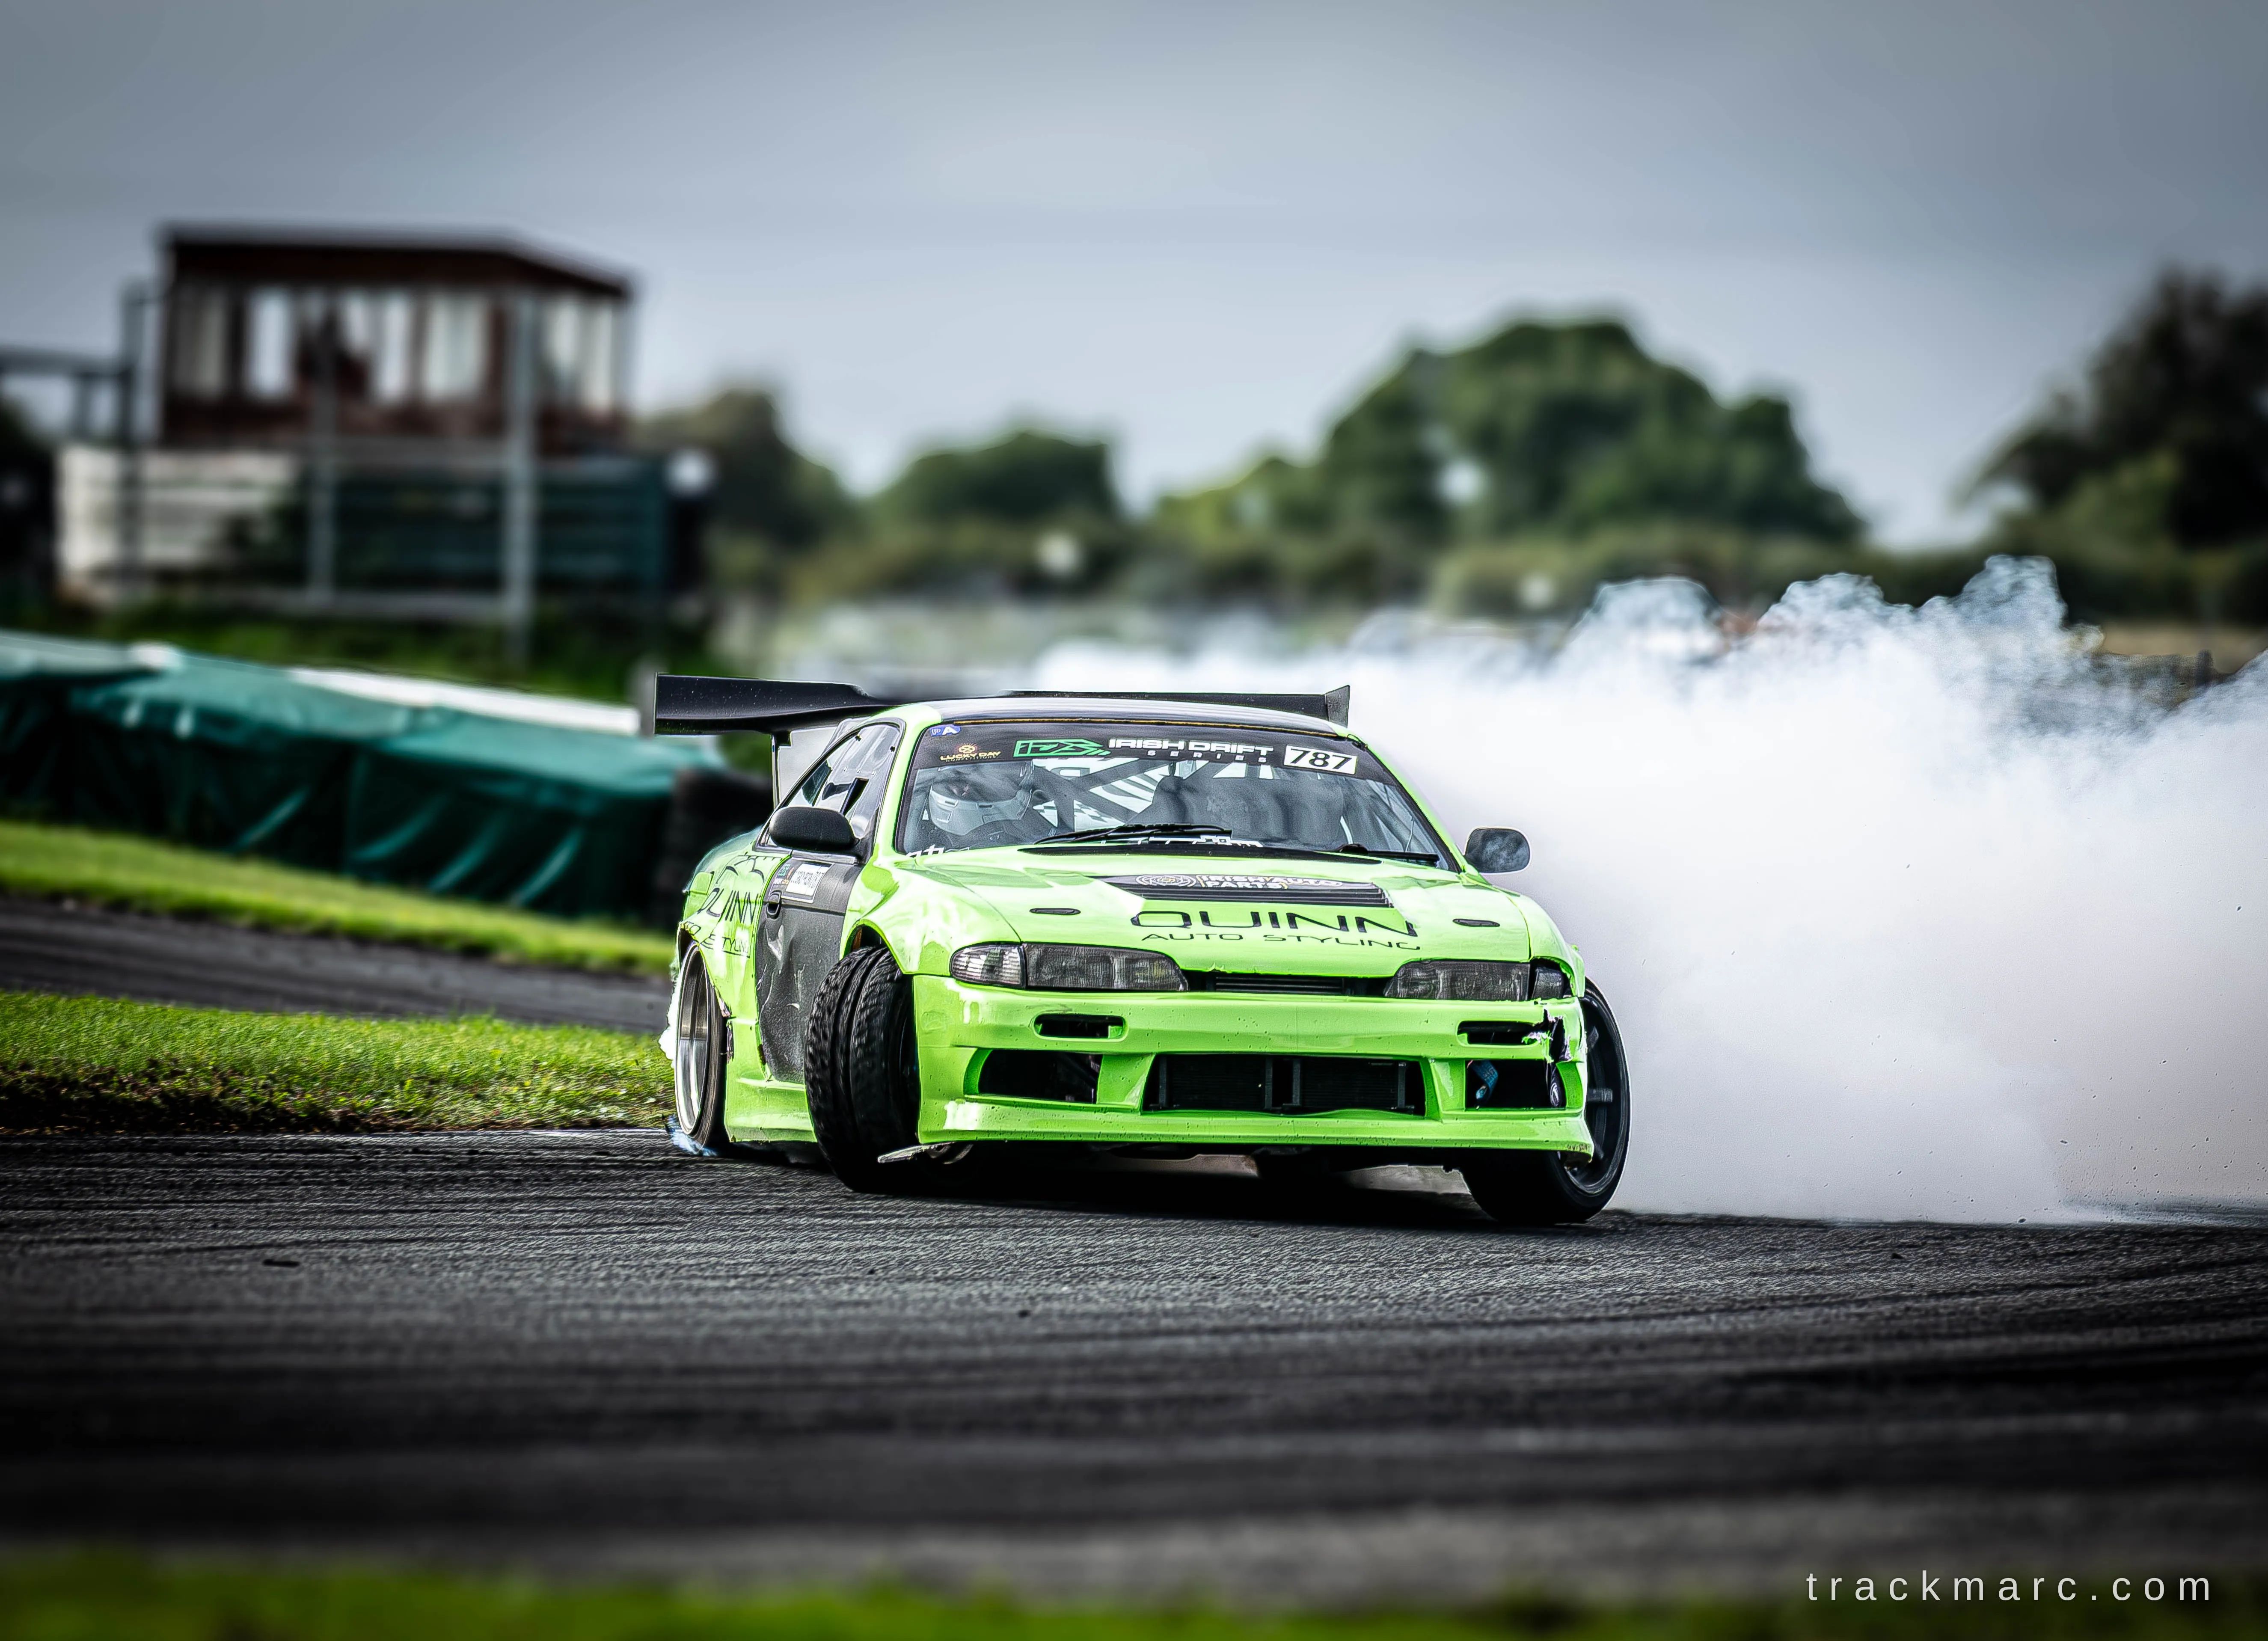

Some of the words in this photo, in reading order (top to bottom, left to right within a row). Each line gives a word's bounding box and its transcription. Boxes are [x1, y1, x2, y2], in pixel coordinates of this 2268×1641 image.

[1109, 739, 1185, 750] IRISH
[1188, 741, 1274, 756] DRIFT
[1147, 750, 1267, 763] SERIES
[1290, 748, 1353, 769] 787
[1205, 881, 1283, 889] PARTS
[1130, 911, 1419, 938] QUINN
[1263, 935, 1421, 951] STYLING
